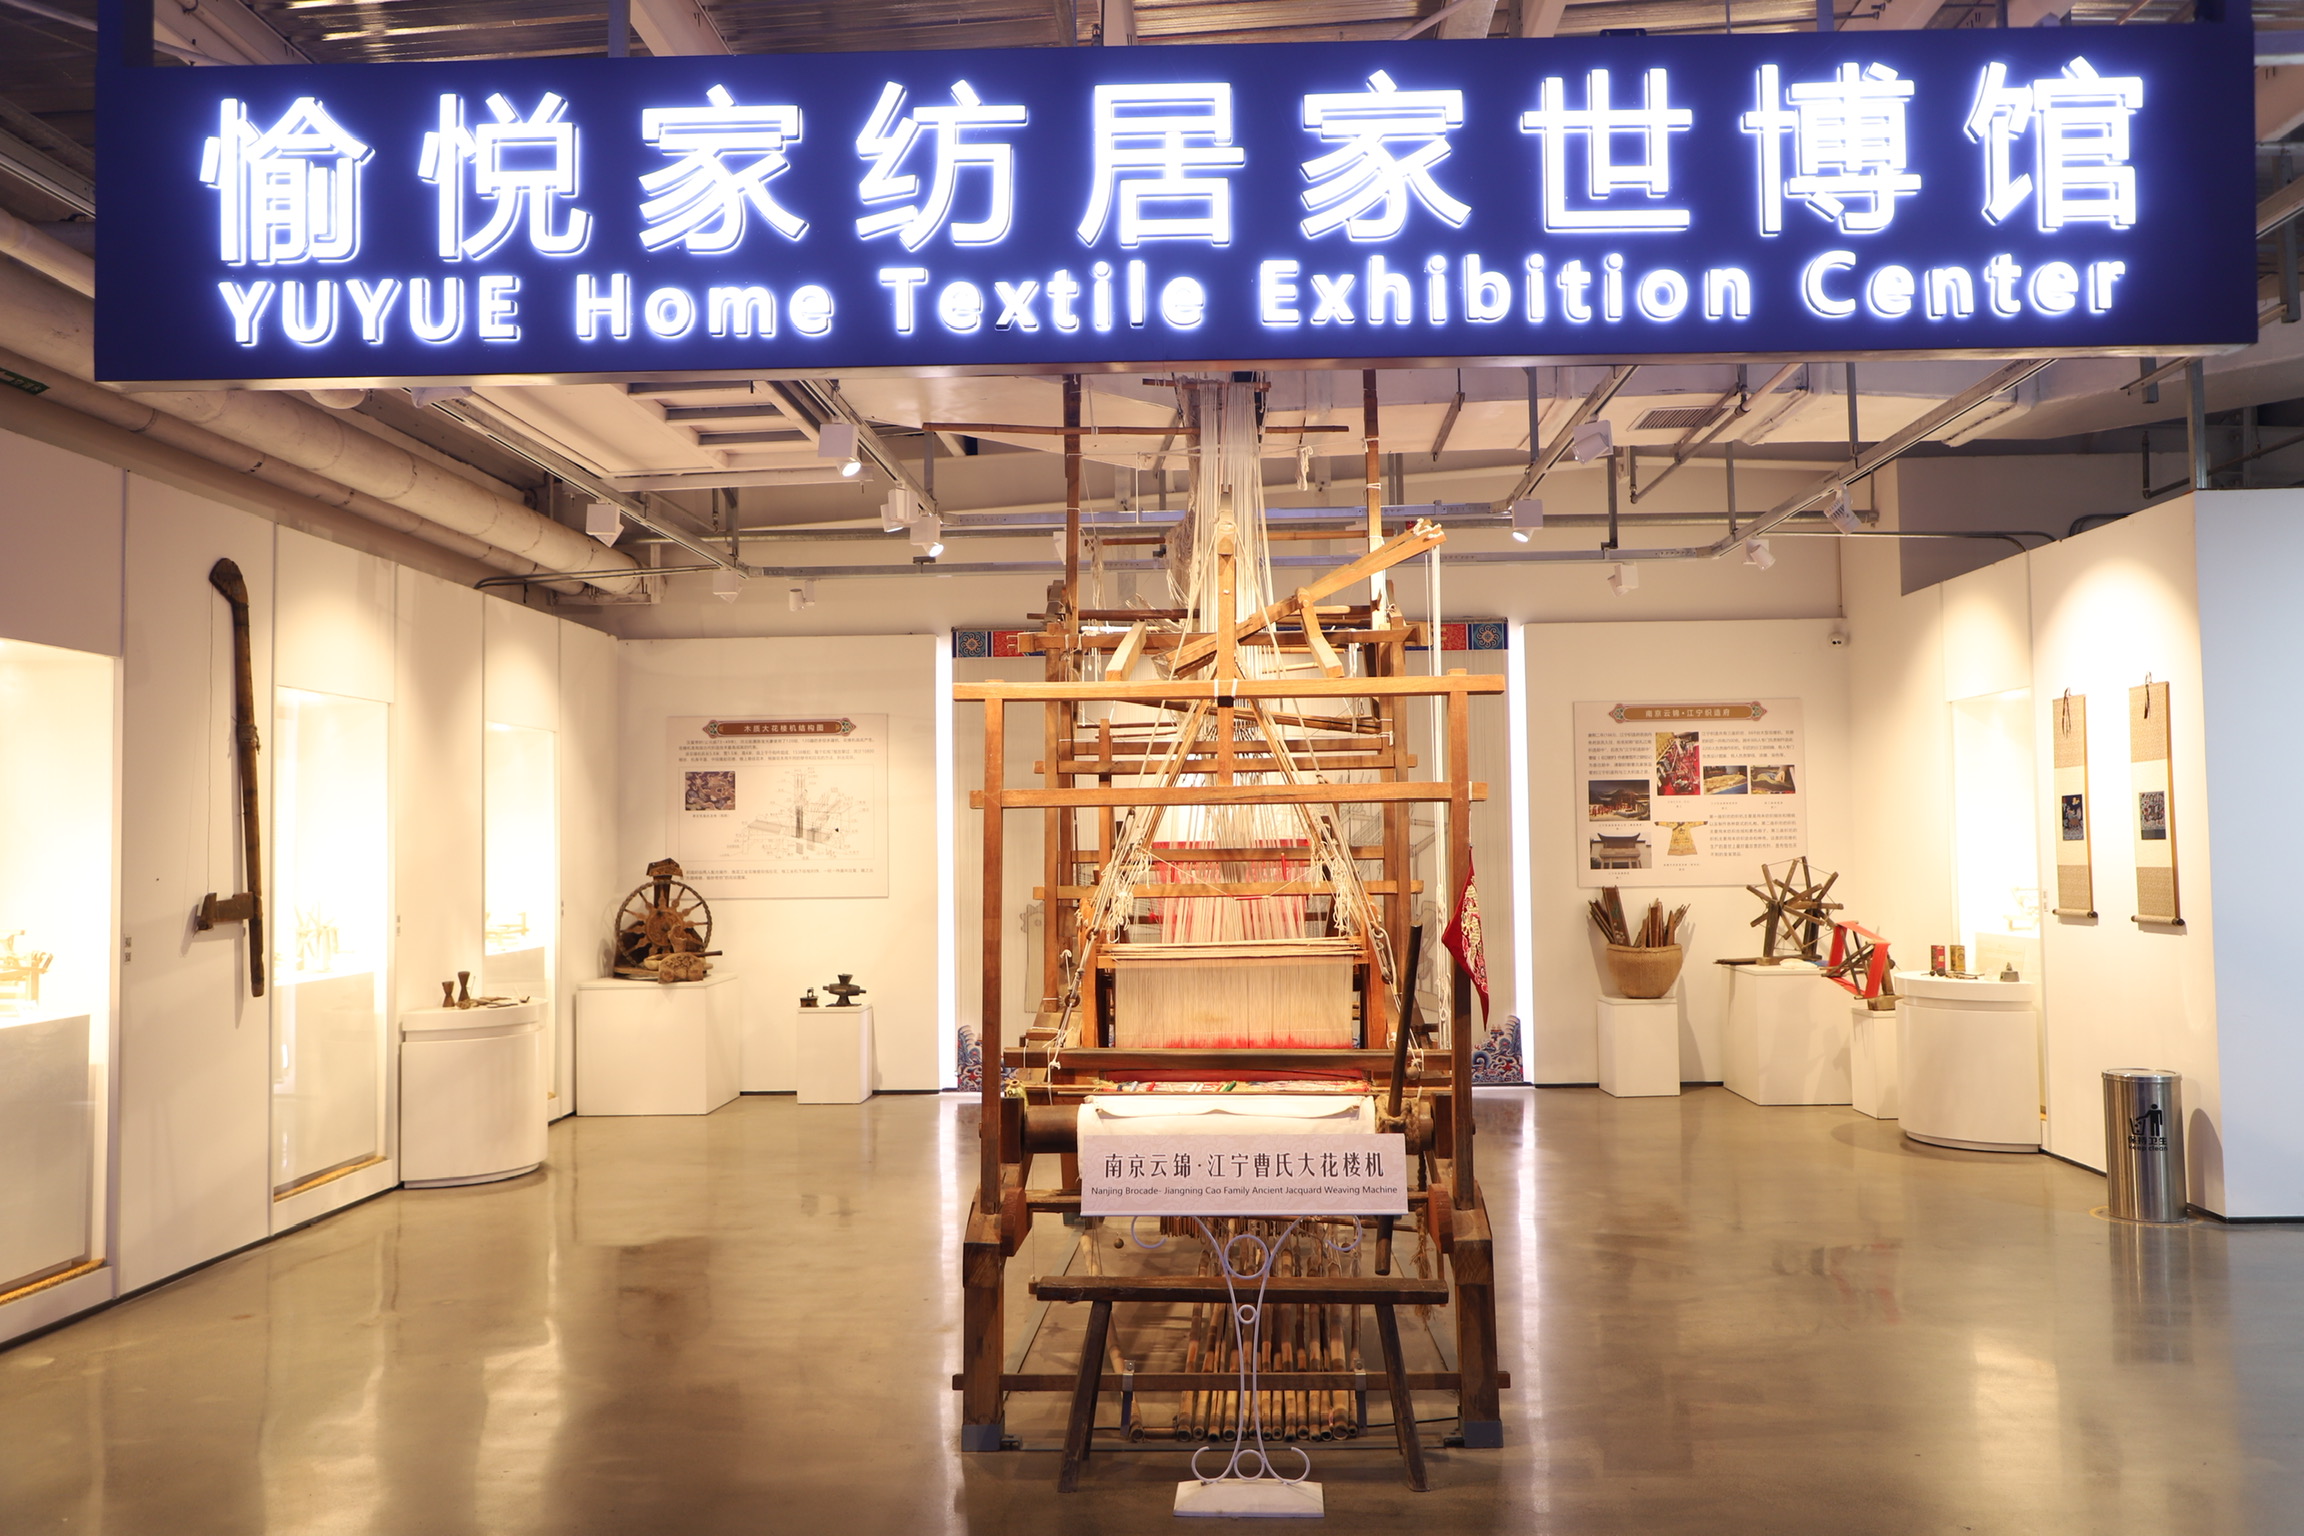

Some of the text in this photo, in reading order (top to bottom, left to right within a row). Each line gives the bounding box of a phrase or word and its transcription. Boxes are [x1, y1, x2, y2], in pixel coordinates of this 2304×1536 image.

[199, 55, 2146, 267] 愉悦家纺居家世博馆
[217, 248, 2127, 347] YUYUE Home Textile Exhibition Center
[1091, 1186, 1124, 1196] Nanjing
[1164, 1186, 1204, 1196] Jiangning
[1205, 1186, 1222, 1195] Cao
[1224, 1186, 1251, 1196] Family
[1252, 1186, 1284, 1195] Ancient
[1285, 1186, 1322, 1196] Jacquard
[1325, 1186, 1361, 1196] Weaving
[1362, 1186, 1398, 1194] Machine
[1104, 1152, 1385, 1180] 南京云锦·江宁曹氏大花楼机
